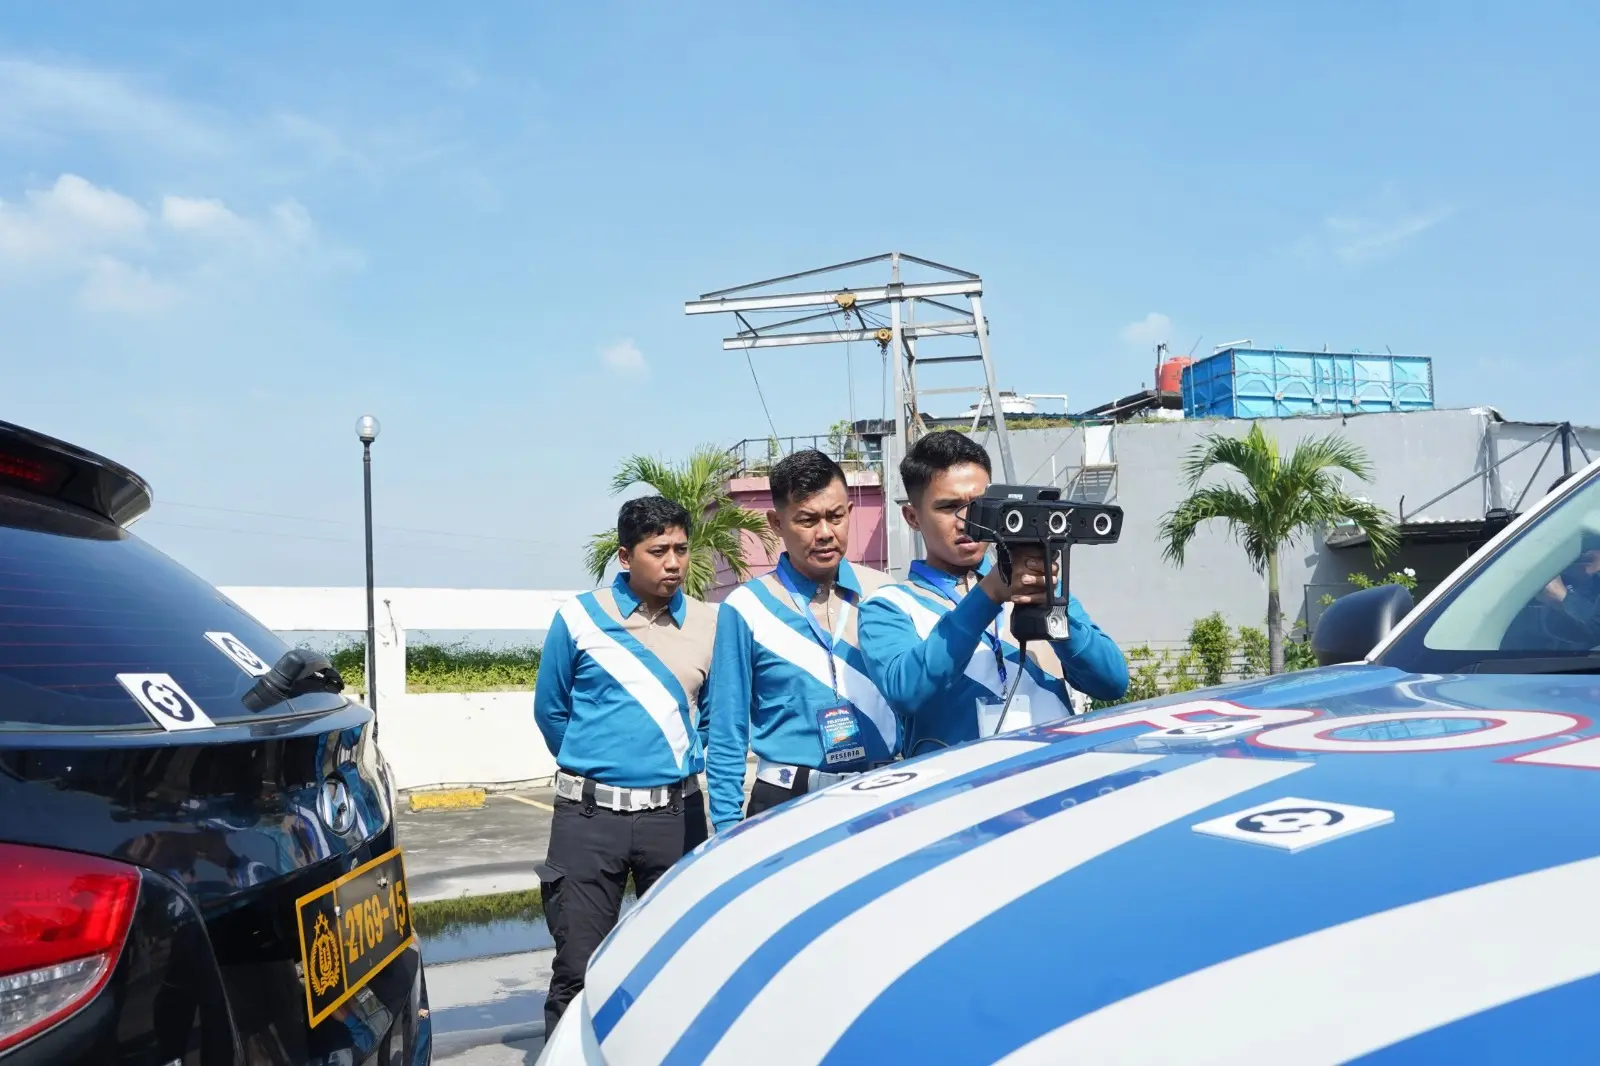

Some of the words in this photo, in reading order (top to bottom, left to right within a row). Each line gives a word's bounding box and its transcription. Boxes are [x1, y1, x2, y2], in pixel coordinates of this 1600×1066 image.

[830, 749, 860, 761] PESERTA
[1047, 699, 1600, 771] PO
[344, 880, 407, 964] 2769-15
